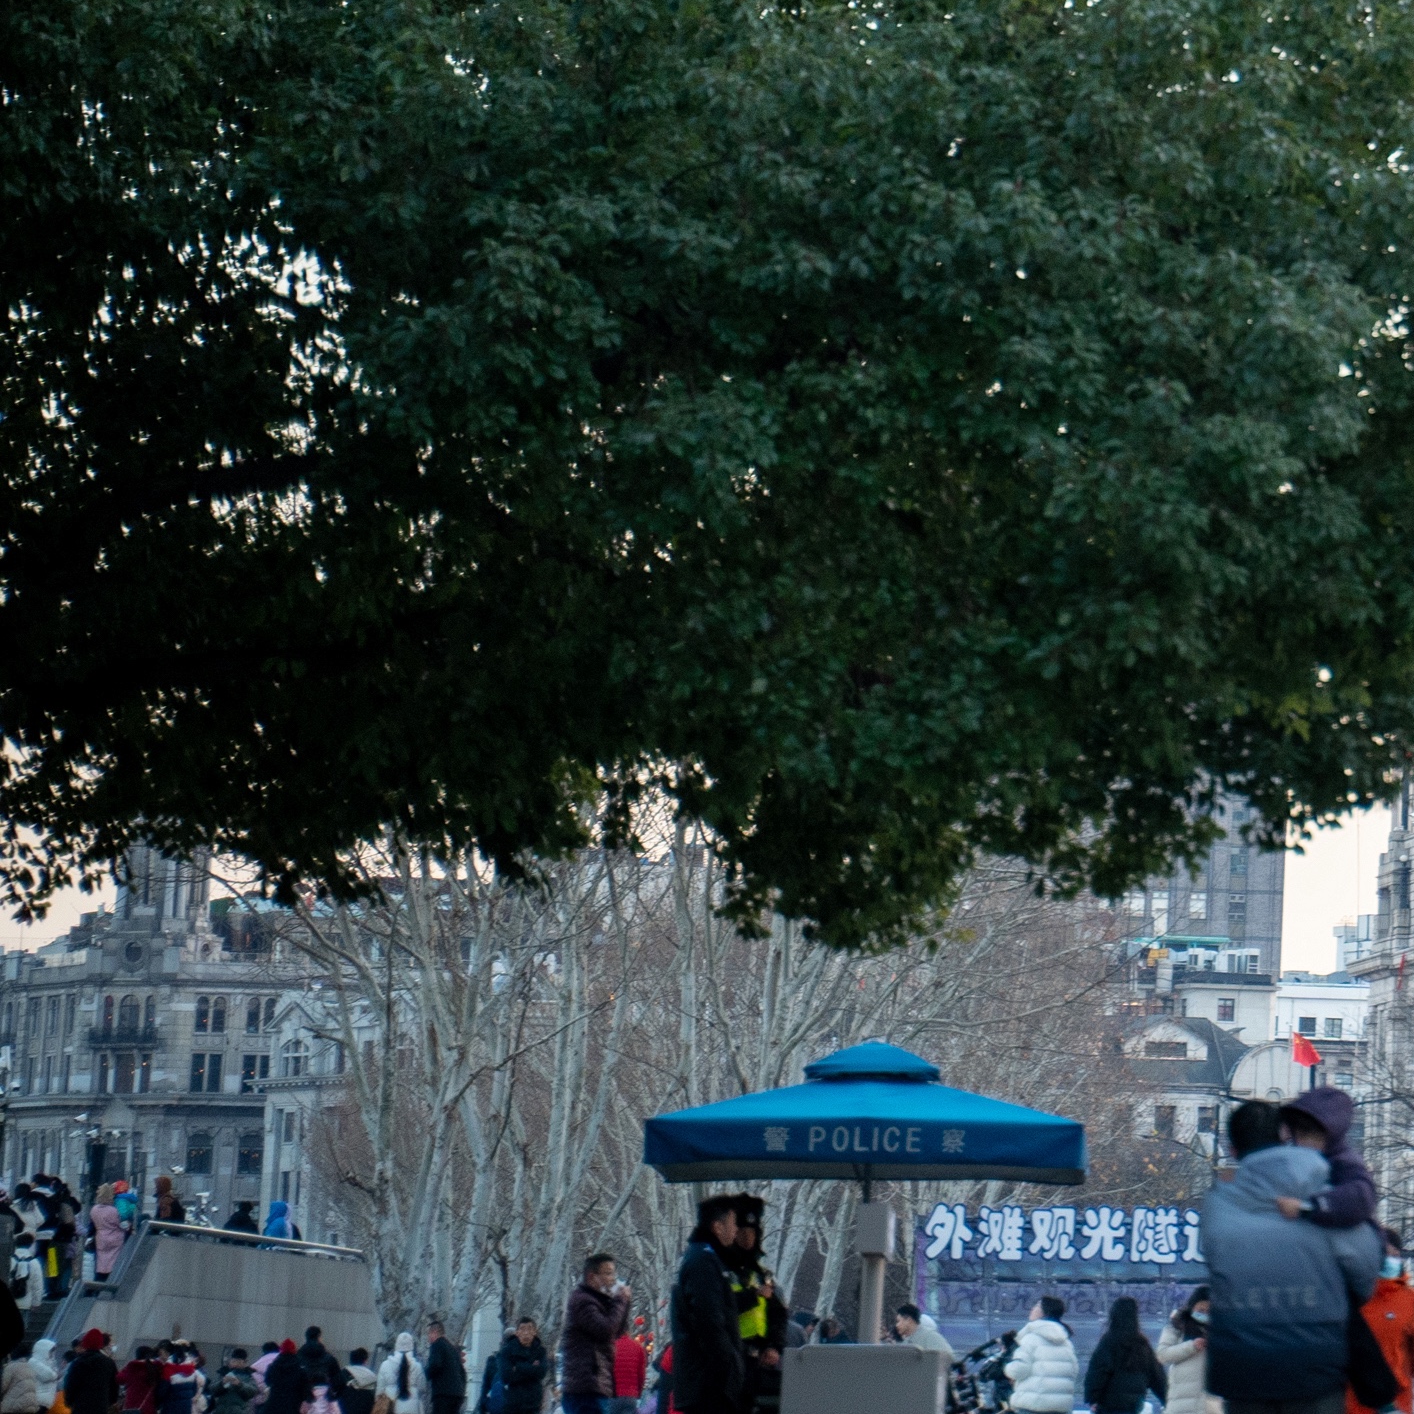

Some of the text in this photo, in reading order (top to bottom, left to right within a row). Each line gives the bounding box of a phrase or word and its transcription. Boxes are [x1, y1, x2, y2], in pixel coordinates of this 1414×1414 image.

[762, 1125, 966, 1153] 警 POLICE 察
